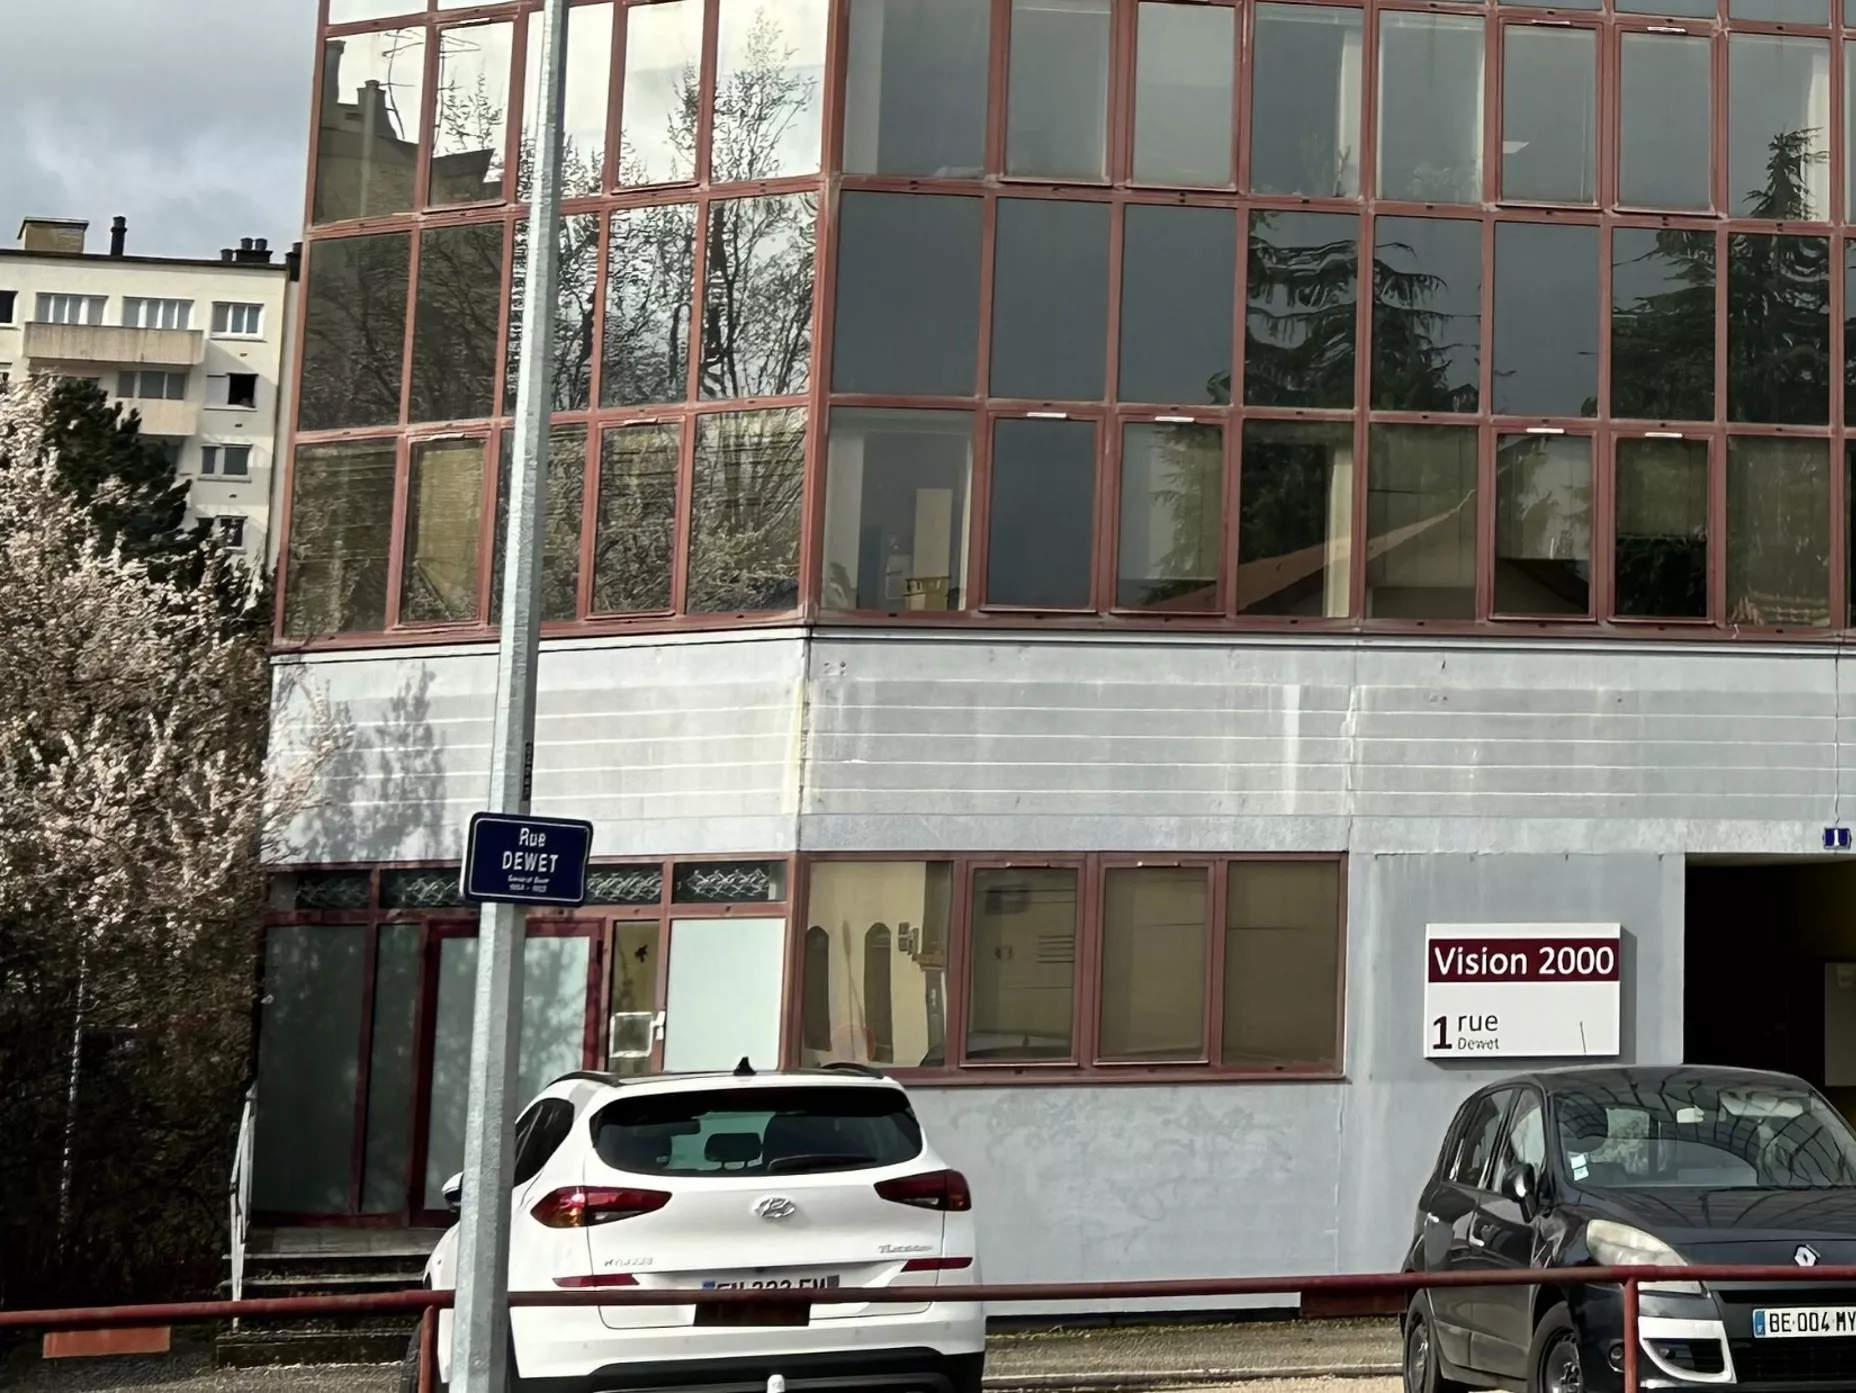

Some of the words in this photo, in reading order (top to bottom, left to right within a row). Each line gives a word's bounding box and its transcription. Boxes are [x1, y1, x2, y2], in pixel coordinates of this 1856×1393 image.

[1833, 828, 1840, 847] 1
[502, 851, 559, 873] DEWET
[1434, 946, 1528, 975] Vision
[1539, 946, 1614, 975] 2000
[1432, 1015, 1452, 1050] 1
[1458, 1014, 1499, 1032] rue
